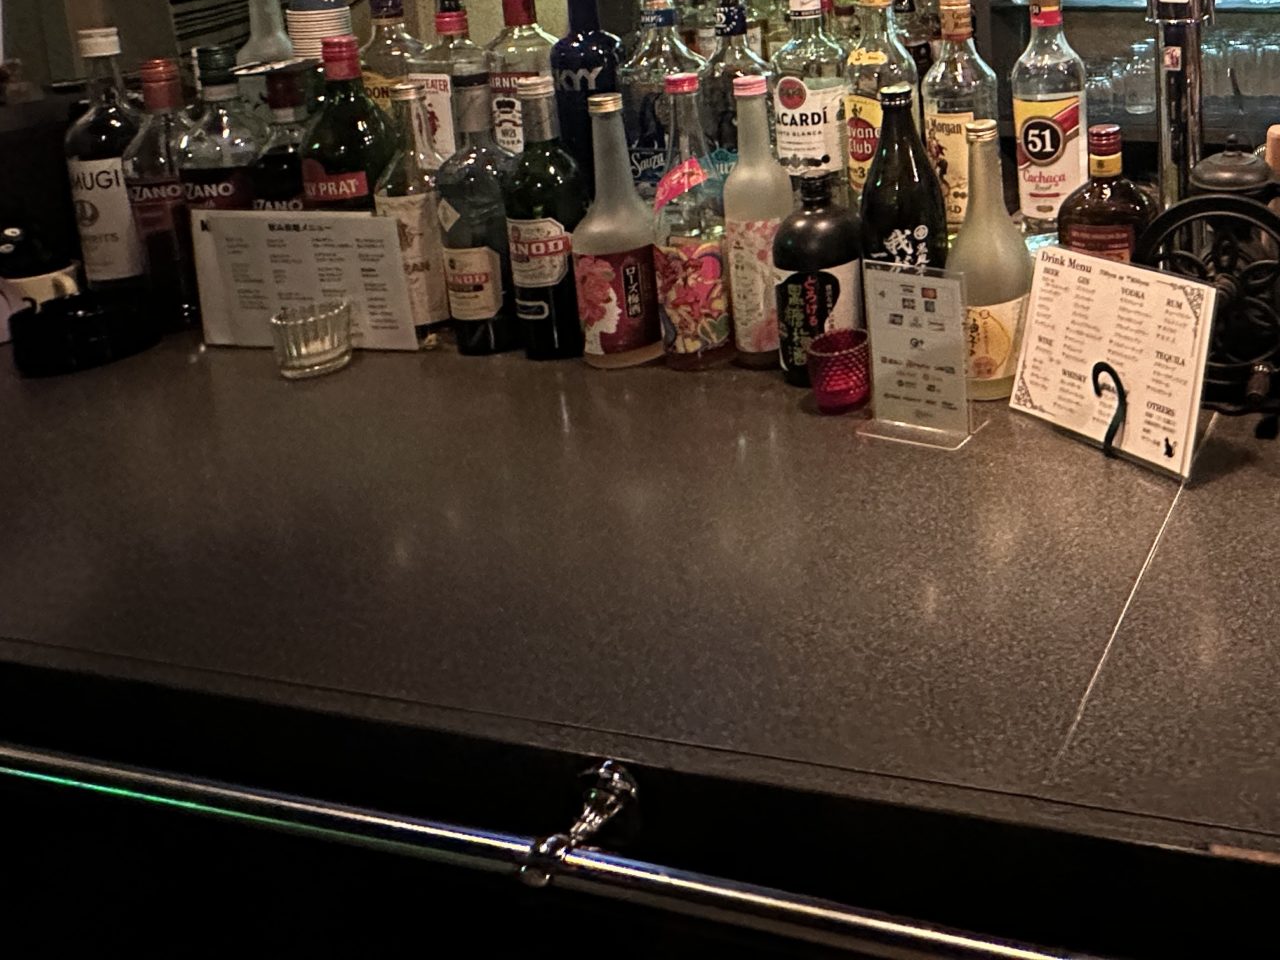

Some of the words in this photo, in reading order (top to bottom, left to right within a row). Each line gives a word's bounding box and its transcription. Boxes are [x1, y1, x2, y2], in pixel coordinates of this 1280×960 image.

[1027, 129, 1055, 153] 51
[631, 152, 666, 177] Sauza
[1040, 251, 1066, 268] Drink
[1067, 257, 1093, 274] Menu
[1120, 287, 1146, 301] VODKA
[1165, 298, 1184, 311] RUM
[1154, 350, 1186, 368] TEQUILA
[1145, 401, 1176, 418] OTHERS
